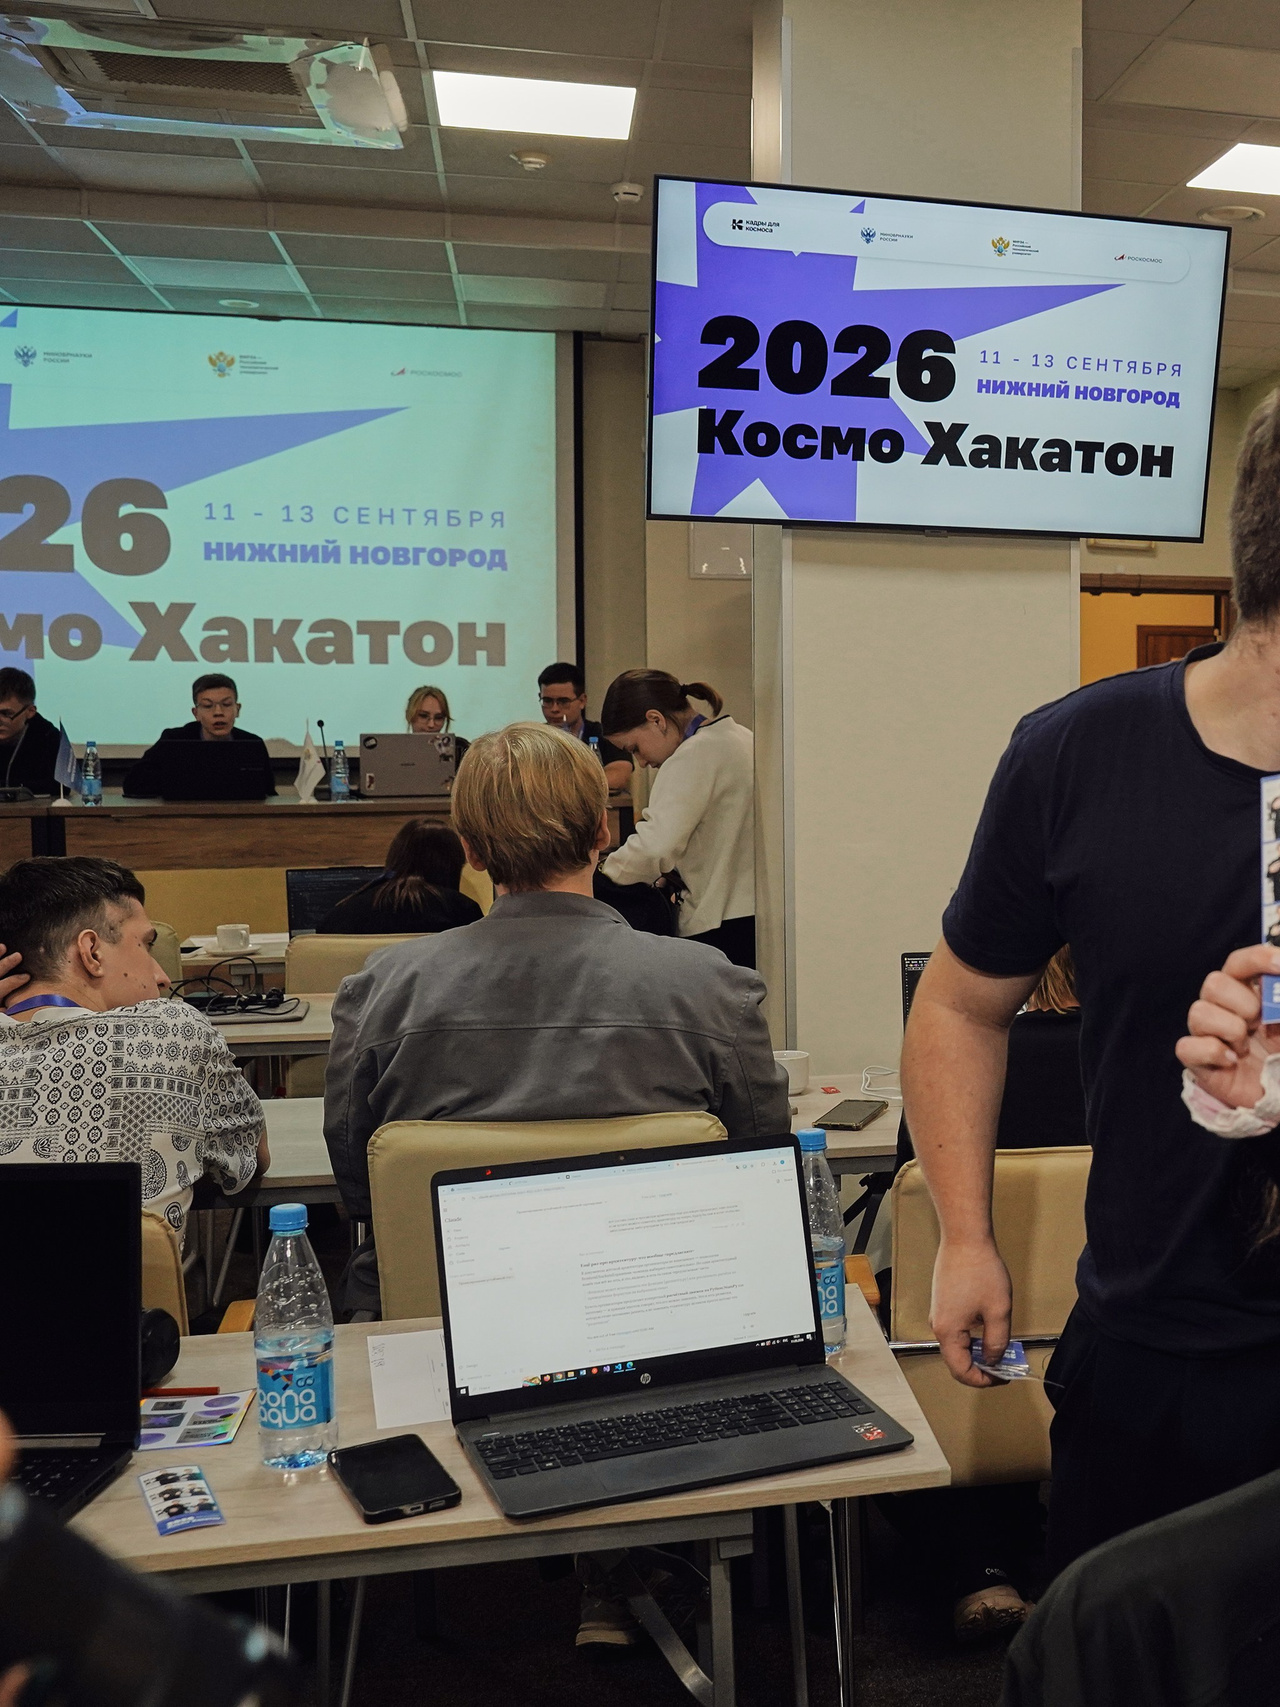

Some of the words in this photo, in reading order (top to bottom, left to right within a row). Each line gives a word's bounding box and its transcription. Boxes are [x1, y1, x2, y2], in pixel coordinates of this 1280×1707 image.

[745, 225, 774, 234] космоса
[746, 220, 767, 229] кадры
[1127, 256, 1163, 264] РОСКОСМОС
[698, 315, 956, 402] 2026
[979, 349, 1002, 364] 11
[1031, 353, 1055, 368] 13
[1066, 357, 1182, 377] СЕНТЯБРЯ
[977, 378, 1070, 399] НИЖНИЙ
[1074, 385, 1181, 409] НОВГОРОД
[697, 408, 905, 463] Космо
[920, 421, 1175, 478] Хакатон
[204, 502, 236, 521] 11
[281, 504, 315, 523] 13
[333, 506, 506, 529] СЕНТЯБРЯ
[203, 538, 342, 565] НИЖНИЙ
[349, 545, 509, 571] НОВГОРОД
[128, 601, 506, 667] Хакатон
